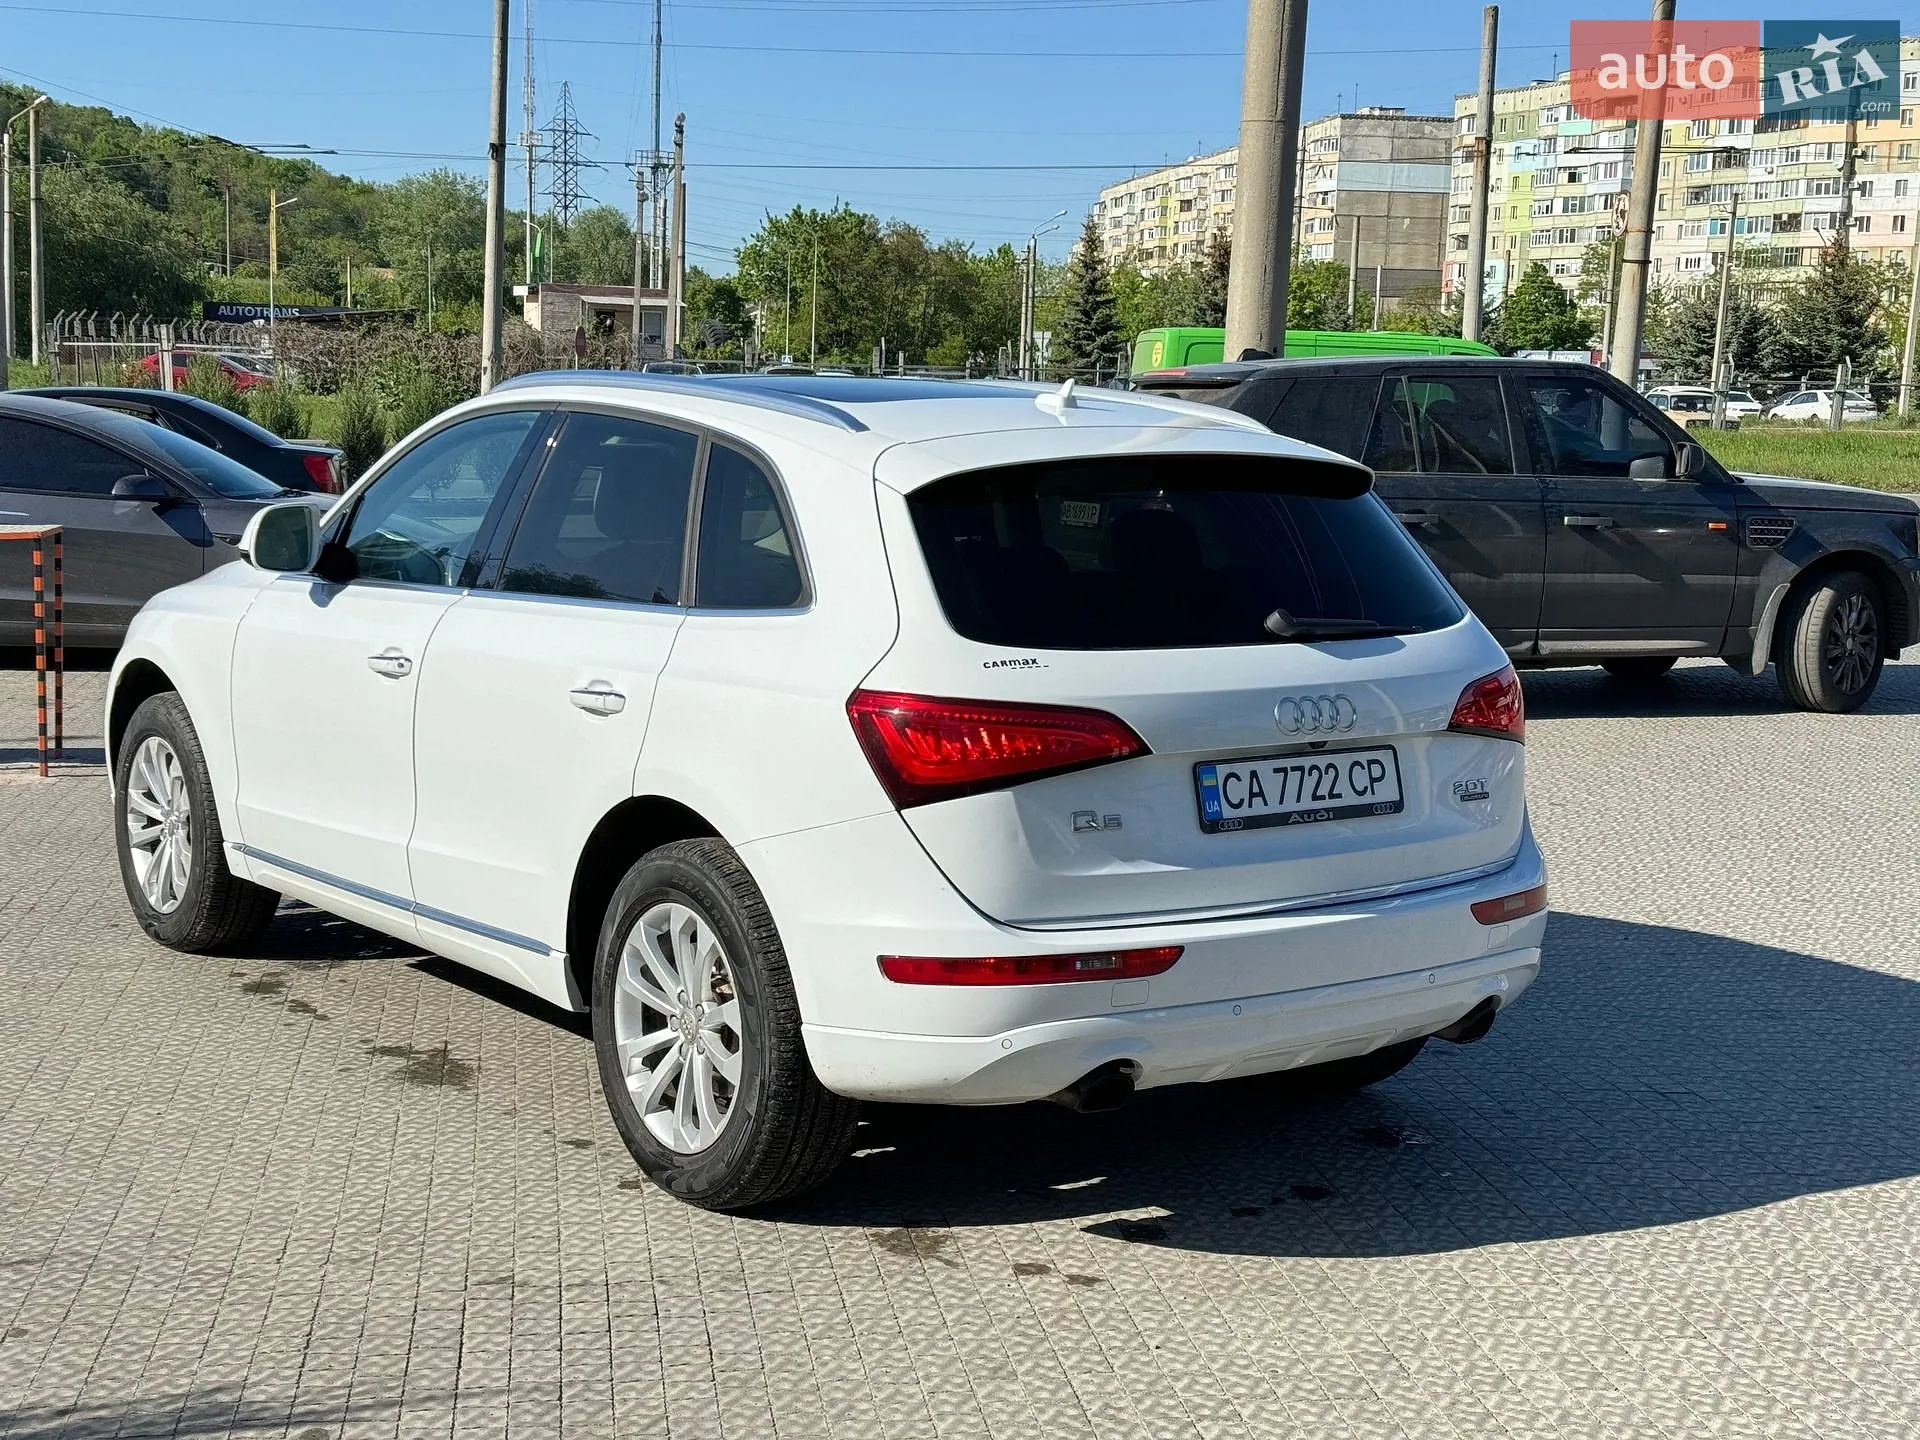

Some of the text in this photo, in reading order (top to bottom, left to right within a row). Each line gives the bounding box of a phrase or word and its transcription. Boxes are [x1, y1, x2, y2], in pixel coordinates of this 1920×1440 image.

[218, 305, 300, 317] AUTOTRANS
[1222, 758, 1387, 810] CA 7722 CP
[1205, 800, 1220, 813] UA
[1071, 810, 1122, 832] Q5
[1287, 810, 1335, 825] Audi
